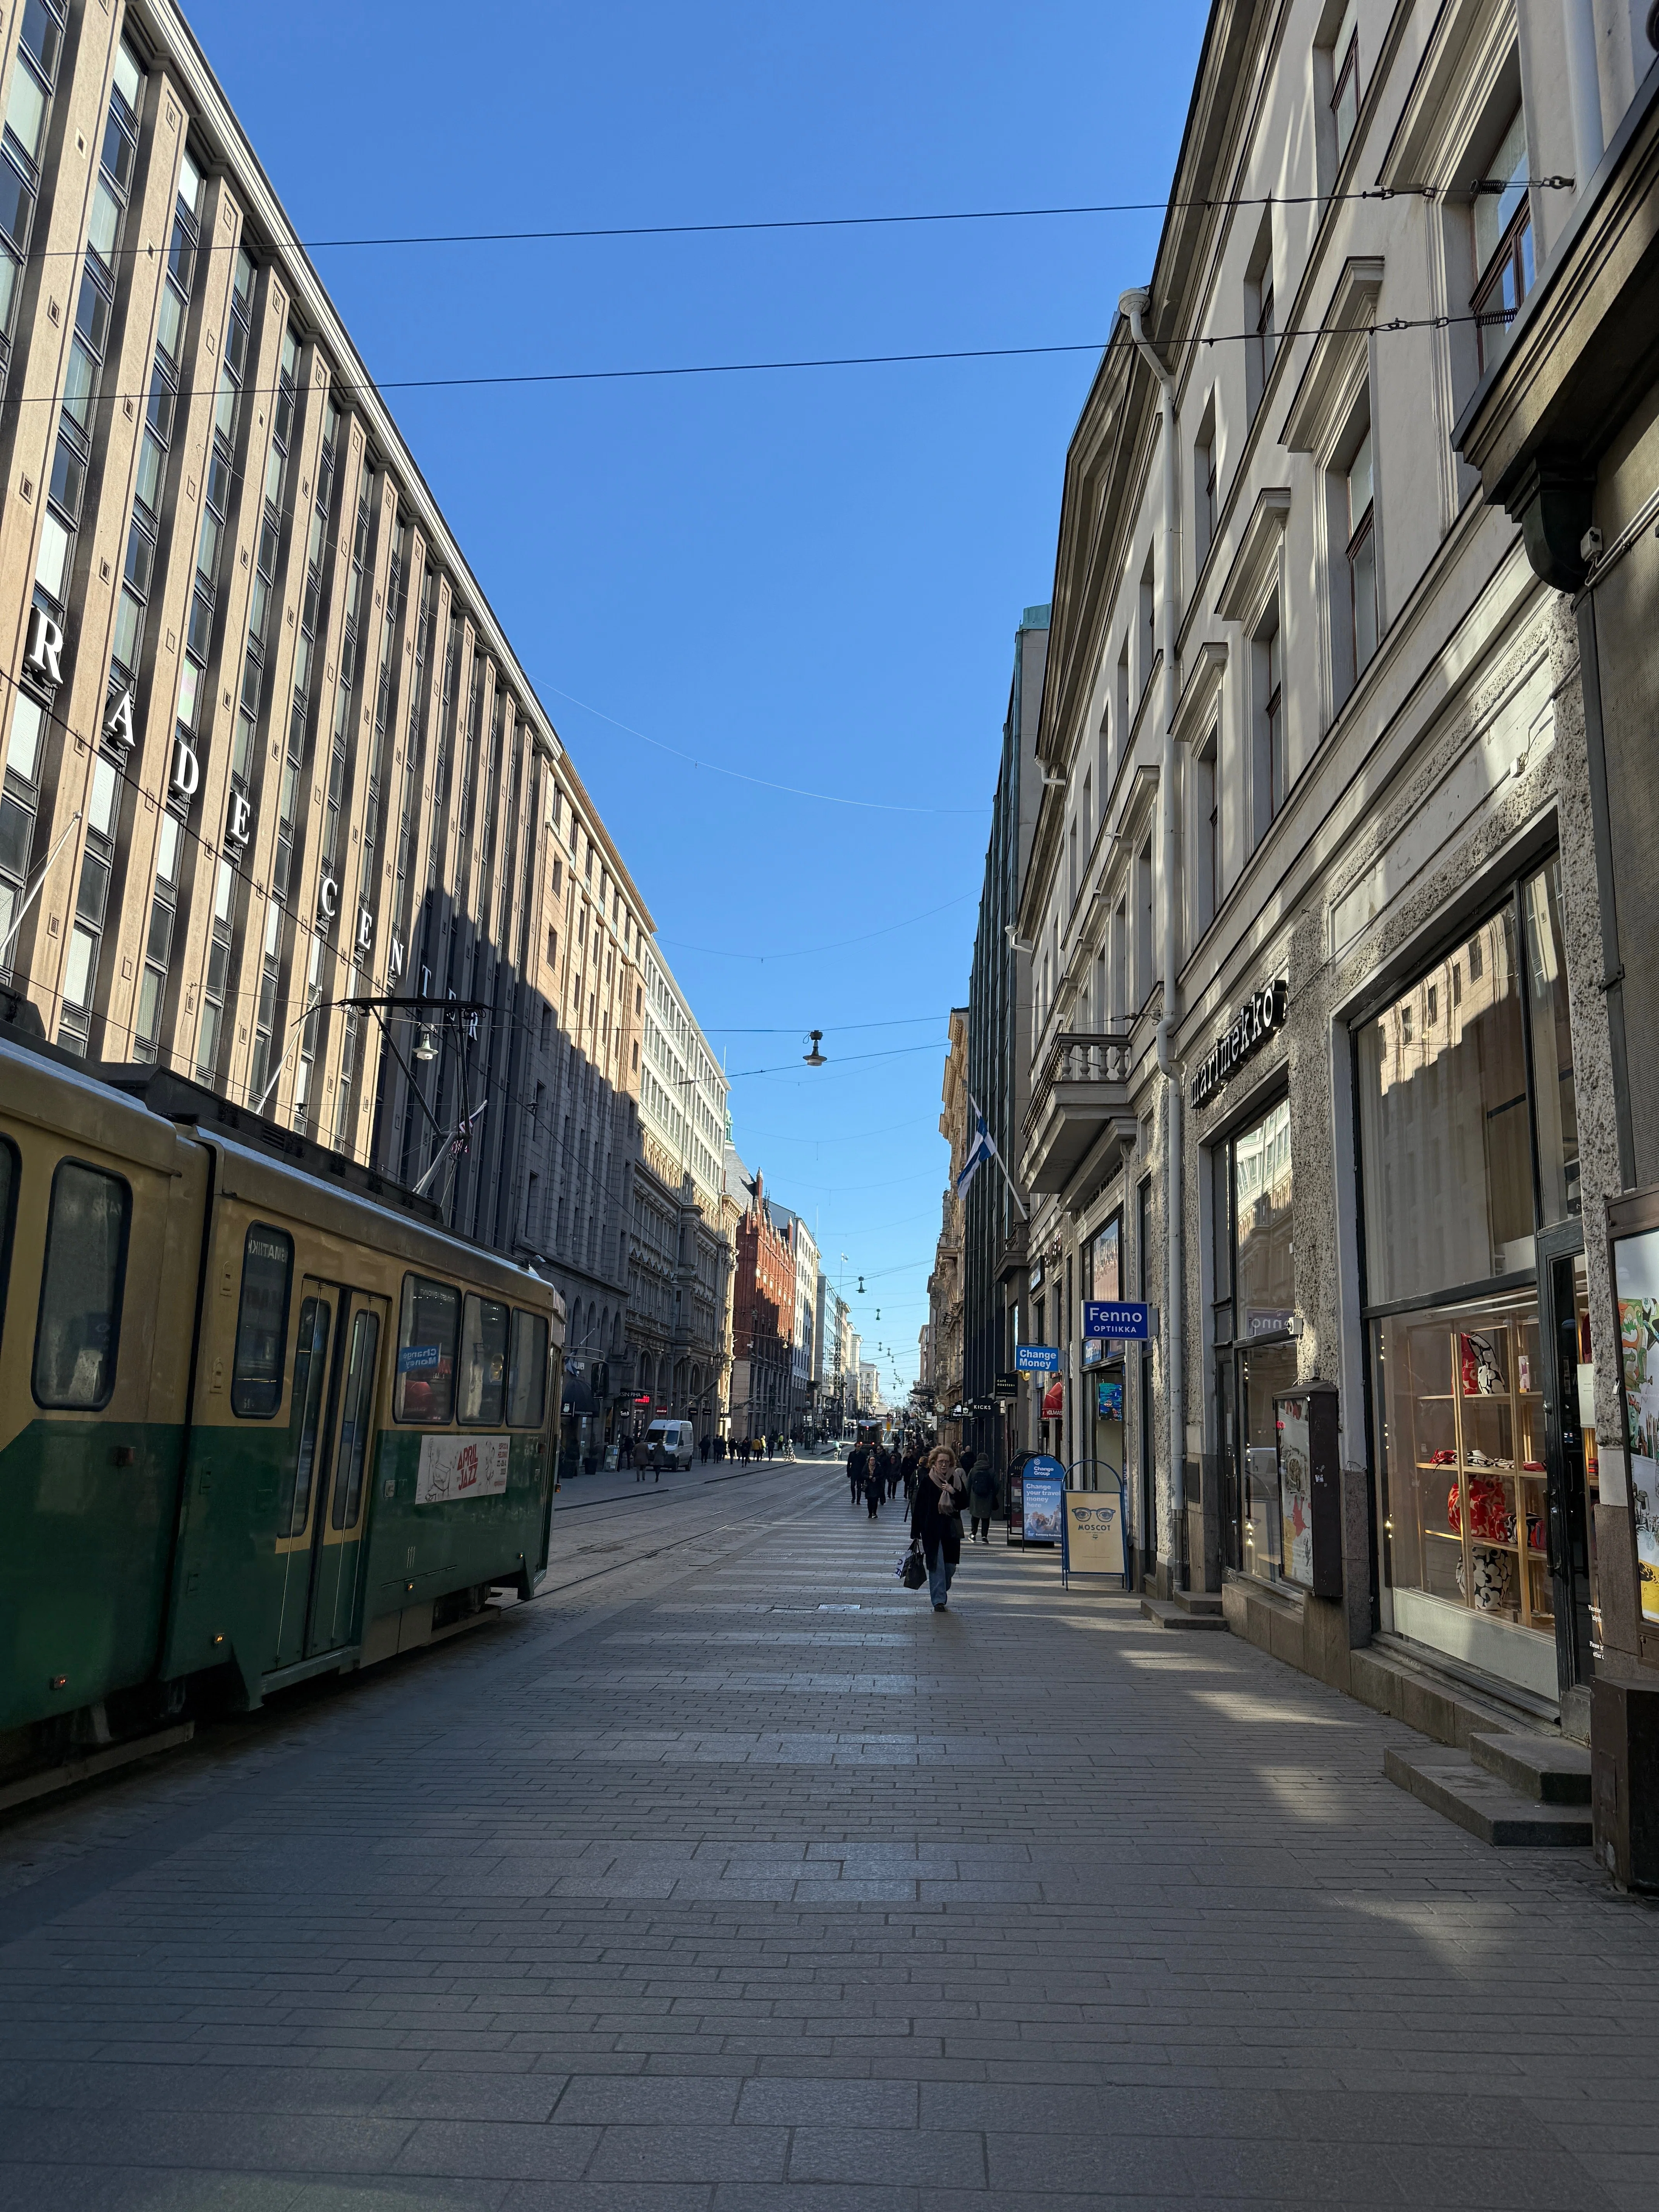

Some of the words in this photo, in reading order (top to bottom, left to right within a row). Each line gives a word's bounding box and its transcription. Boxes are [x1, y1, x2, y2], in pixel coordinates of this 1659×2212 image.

[1190, 987, 1273, 1109] marimekko
[1089, 1307, 1142, 1322] Fenno
[1019, 1349, 1057, 1360] Change
[1019, 1358, 1051, 1370] Money
[457, 1443, 479, 1471] APRIL
[458, 1462, 478, 1491] JAZZ
